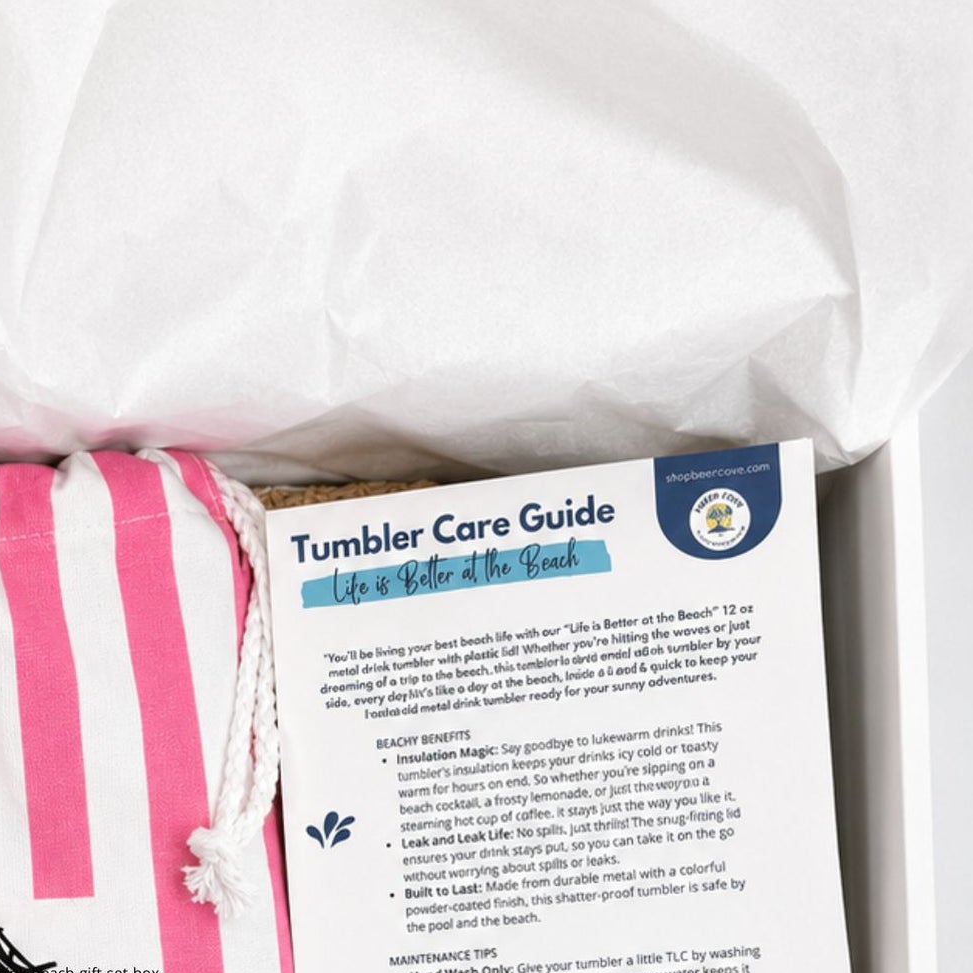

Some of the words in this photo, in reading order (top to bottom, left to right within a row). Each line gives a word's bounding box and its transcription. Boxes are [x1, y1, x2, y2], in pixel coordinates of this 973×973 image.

[291, 522, 425, 563] Tumbler
[432, 514, 511, 544] Care
[519, 495, 616, 532] Guide
[332, 567, 369, 605] Life
[376, 574, 390, 596] is
[397, 555, 454, 596] Better
[485, 547, 512, 583] the
[519, 537, 580, 579] Beach
[408, 644, 432, 656] your
[434, 639, 458, 650] best
[495, 631, 513, 642] life
[515, 628, 540, 639] with
[542, 628, 561, 637] our
[592, 621, 601, 630] is
[603, 618, 638, 629] Better
[723, 604, 736, 615] 12
[437, 653, 462, 664] with
[651, 628, 670, 640] the
[729, 620, 750, 634] just
[354, 695, 385, 706] every
[435, 685, 455, 696] like
[650, 658, 682, 674] quick
[685, 659, 697, 668] to
[699, 655, 728, 666] keep
[731, 652, 758, 665] your
[400, 675, 419, 685] trip
[422, 674, 433, 682] to
[494, 661, 515, 673] this
[483, 692, 526, 706] tumbler
[564, 685, 581, 697] for
[583, 685, 609, 697] your
[612, 681, 646, 692] sunny
[648, 673, 717, 687] adventures.
[376, 736, 418, 750] BEACHY
[421, 730, 471, 745] BENEFITS
[397, 749, 457, 764] Insulation
[460, 745, 498, 759] Magic:
[501, 743, 521, 756] Say
[524, 739, 574, 755] goodbye
[577, 737, 589, 746] to
[592, 731, 650, 744] lukewarm
[697, 722, 722, 733] This
[453, 761, 509, 776] insulation
[512, 759, 547, 770] keeps
[548, 756, 576, 770] your
[578, 751, 615, 763] drinks
[618, 749, 634, 762] icy
[637, 745, 662, 758] cold
[665, 745, 678, 754] or
[398, 787, 430, 798] warm
[433, 783, 449, 795] for
[452, 782, 485, 793] hours
[642, 762, 686, 776] sipping
[402, 836, 430, 849] Leak
[432, 834, 455, 846] and
[457, 831, 486, 844] Leak
[488, 828, 514, 841] Life:
[517, 828, 534, 838] No
[631, 817, 654, 827] The
[476, 815, 498, 826] cup
[571, 841, 585, 851] so
[587, 840, 610, 852] you
[613, 837, 634, 847] can
[637, 833, 663, 845] take
[677, 831, 692, 841] on
[696, 828, 716, 839] the
[719, 828, 734, 840] go
[405, 887, 433, 899] Built
[436, 887, 449, 897] to
[452, 883, 483, 895] Last:
[603, 870, 636, 882] metal
[639, 867, 665, 879] with
[669, 868, 676, 877] a
[680, 861, 726, 875] colorful
[637, 883, 685, 897] tumbler
[702, 879, 727, 891] safe
[731, 878, 746, 891] by
[503, 912, 541, 925] beach.
[390, 950, 470, 966] MAINTENANCE
[473, 948, 497, 959] TIPS
[575, 957, 622, 969] tumbler
[666, 951, 688, 962] TLC
[692, 950, 706, 963] by
[709, 946, 761, 959] washing
